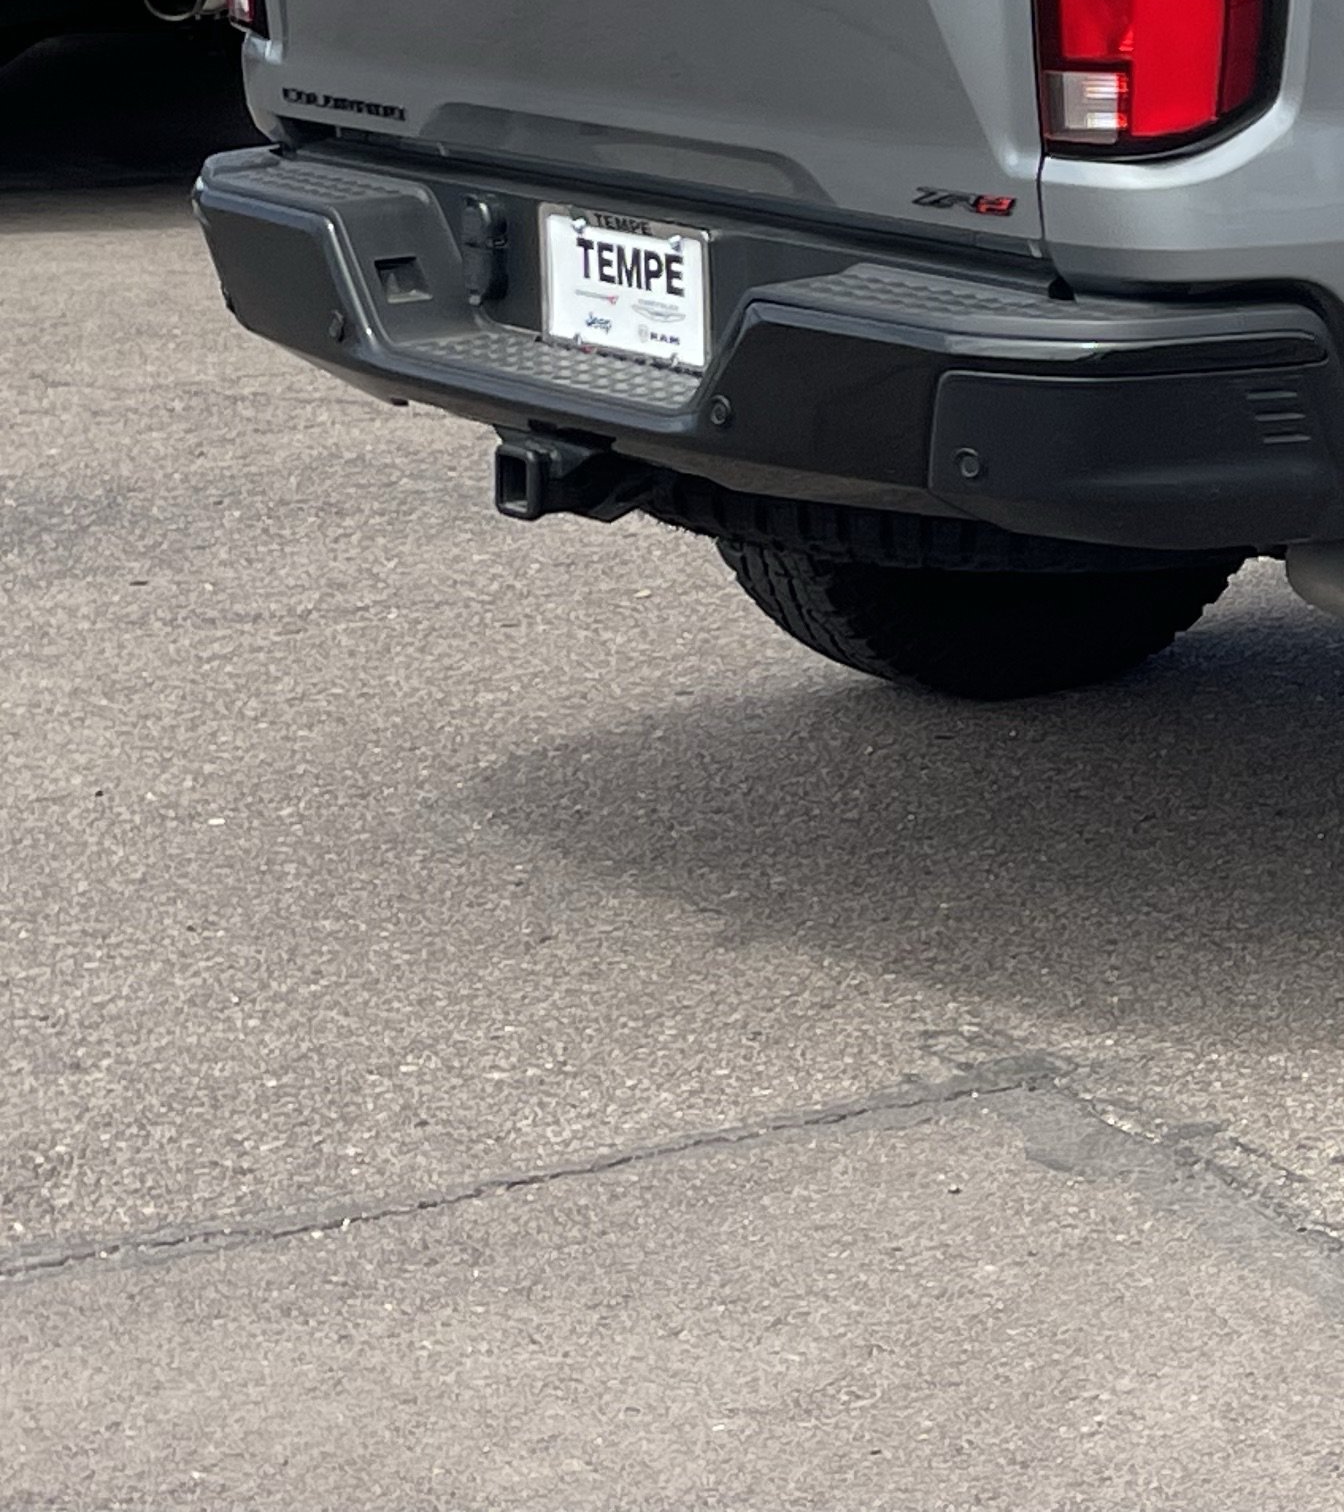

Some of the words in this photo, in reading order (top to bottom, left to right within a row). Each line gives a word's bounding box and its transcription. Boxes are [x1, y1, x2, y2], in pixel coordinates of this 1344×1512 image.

[911, 185, 1019, 217] ZR2
[593, 212, 654, 237] TEMPE
[576, 238, 685, 297] TEMPE
